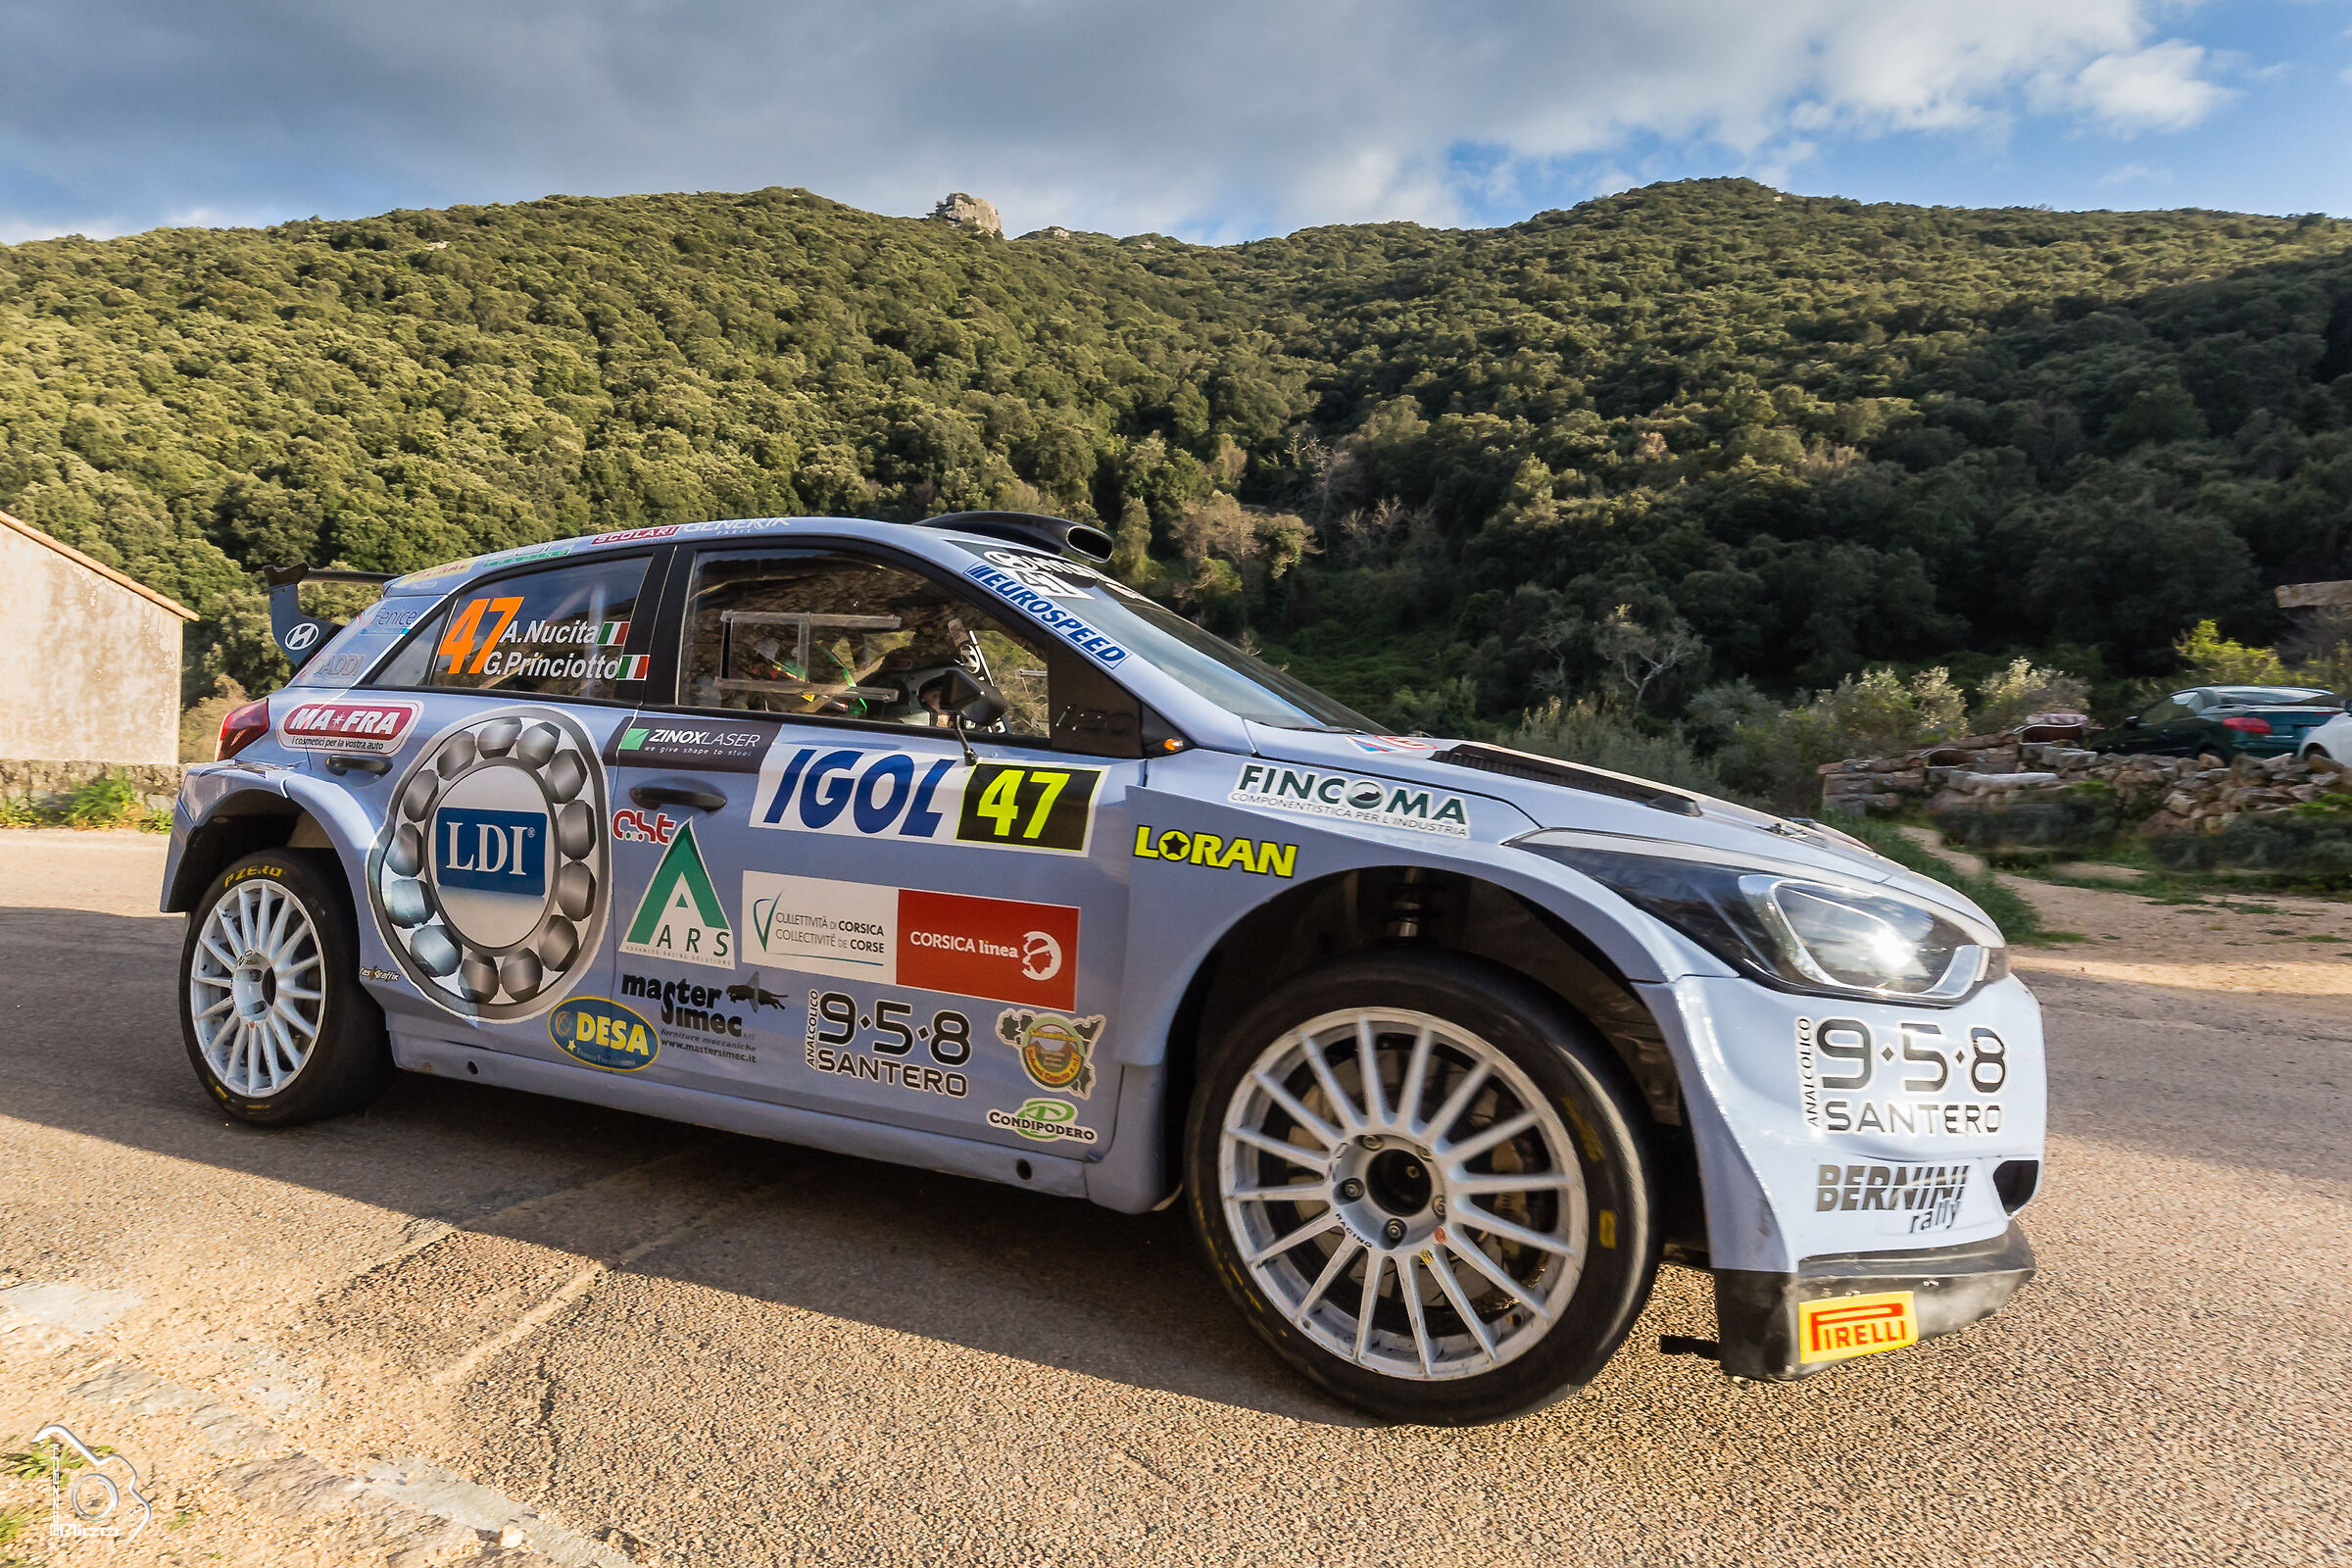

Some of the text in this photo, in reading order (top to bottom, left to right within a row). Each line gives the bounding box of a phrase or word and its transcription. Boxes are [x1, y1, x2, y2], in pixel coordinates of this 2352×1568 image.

[596, 526, 675, 543] SCOLARI
[374, 607, 417, 625] Fenice
[498, 619, 601, 644] A.Nucita
[986, 573, 1126, 662] EUROSPEED
[439, 597, 525, 674] 47
[483, 651, 620, 679] G.Princiotto
[296, 737, 325, 747] cosmetici
[325, 739, 337, 748] per
[345, 740, 366, 749] vostra
[649, 729, 760, 748] ZINOXLASER
[763, 749, 956, 836] IGOL
[977, 768, 1071, 839] 47
[1239, 764, 1467, 825] FINCOMA
[1231, 792, 1467, 837] COMPONENTISTICA PER L'INDUSTRIA
[1133, 824, 1298, 878] LORAN
[657, 924, 730, 957] ARS
[838, 920, 885, 937] CORSICA
[909, 931, 1019, 958] CORSICA linea
[838, 939, 848, 949] DE
[850, 940, 884, 954] CORSE
[575, 1011, 649, 1056] DESA
[661, 1028, 758, 1053] forniture meccaniche
[807, 990, 819, 1067] ANALCOLICO
[661, 1038, 758, 1063] www.mastersimec.it
[818, 1050, 967, 1098] SANTERO
[989, 1111, 1095, 1141] CONDIPODERO
[1826, 1101, 2001, 1134] SANTERO
[1817, 1164, 1970, 1212] BERNINI
[1910, 1198, 1963, 1233] rally
[1811, 1302, 1905, 1351] PIRELLI
